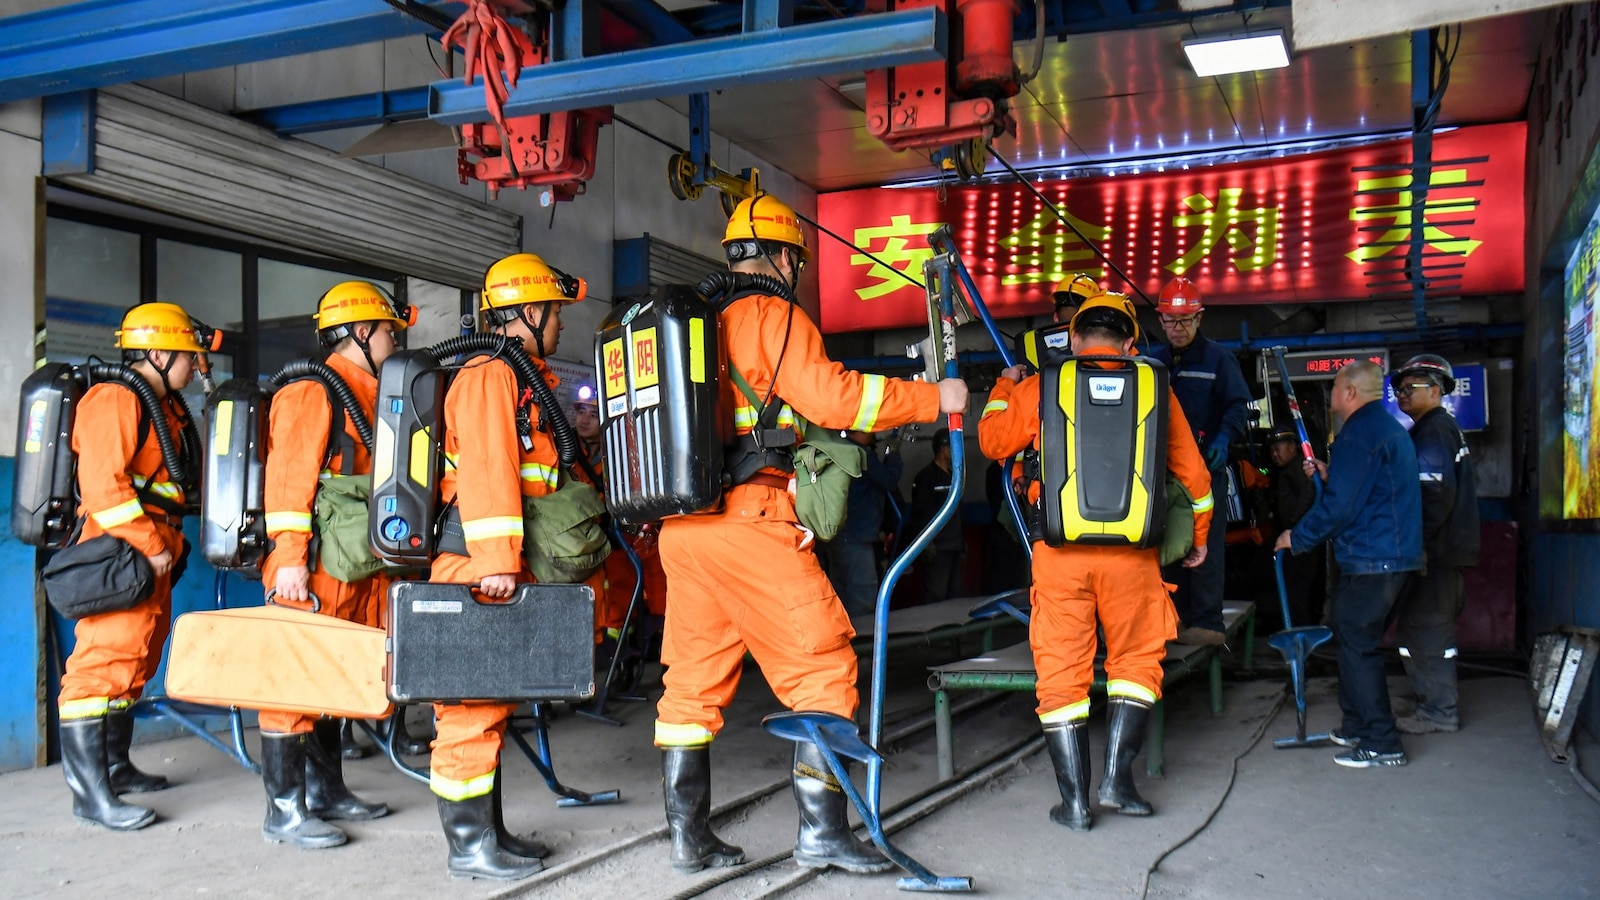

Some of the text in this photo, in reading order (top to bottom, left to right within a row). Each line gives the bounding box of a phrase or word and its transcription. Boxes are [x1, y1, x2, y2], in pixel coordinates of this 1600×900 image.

[850, 169, 1483, 300] 安全为天
[1096, 383, 1117, 392] Dräger
